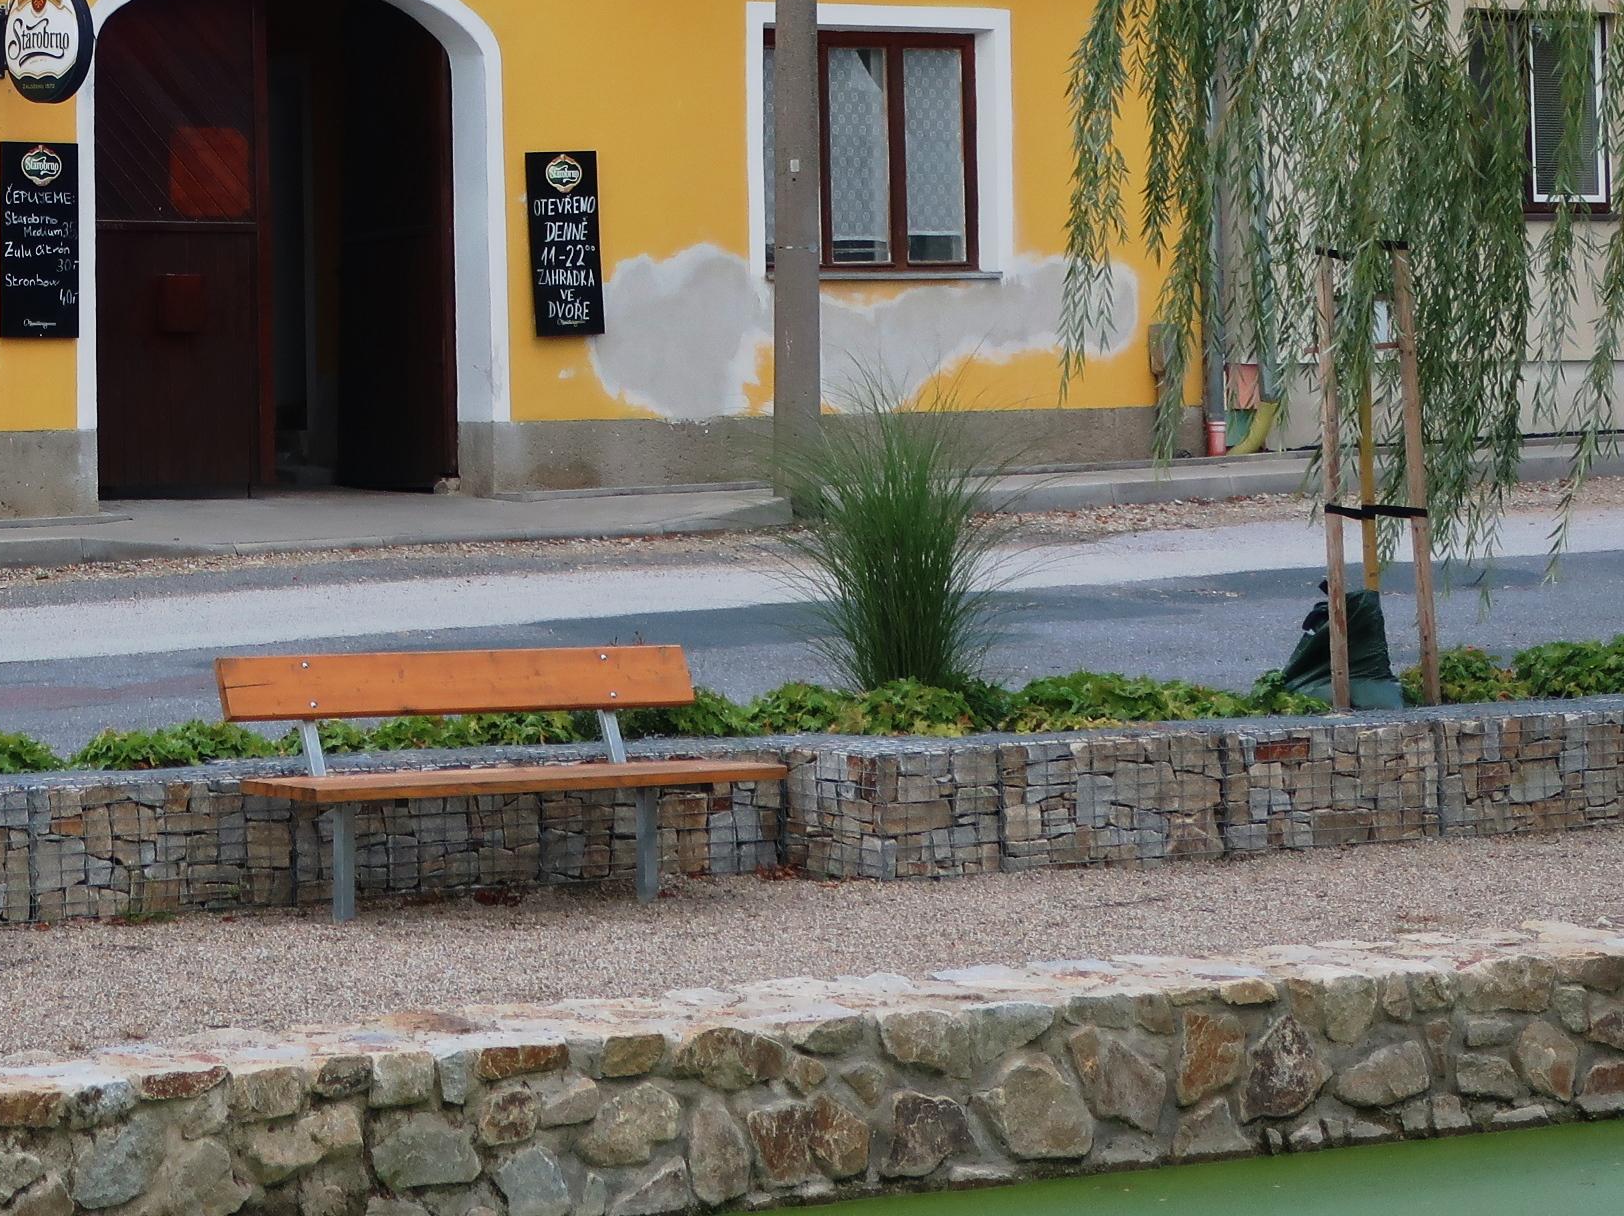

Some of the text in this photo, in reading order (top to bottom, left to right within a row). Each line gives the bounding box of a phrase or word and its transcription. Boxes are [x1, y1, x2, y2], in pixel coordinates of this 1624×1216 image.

[7, 17, 70, 69] Starobrno
[533, 194, 596, 216] OTEVŘENO
[545, 218, 588, 243] DENNĚ
[560, 288, 575, 301] VE
[548, 296, 591, 320] DVOŘE
